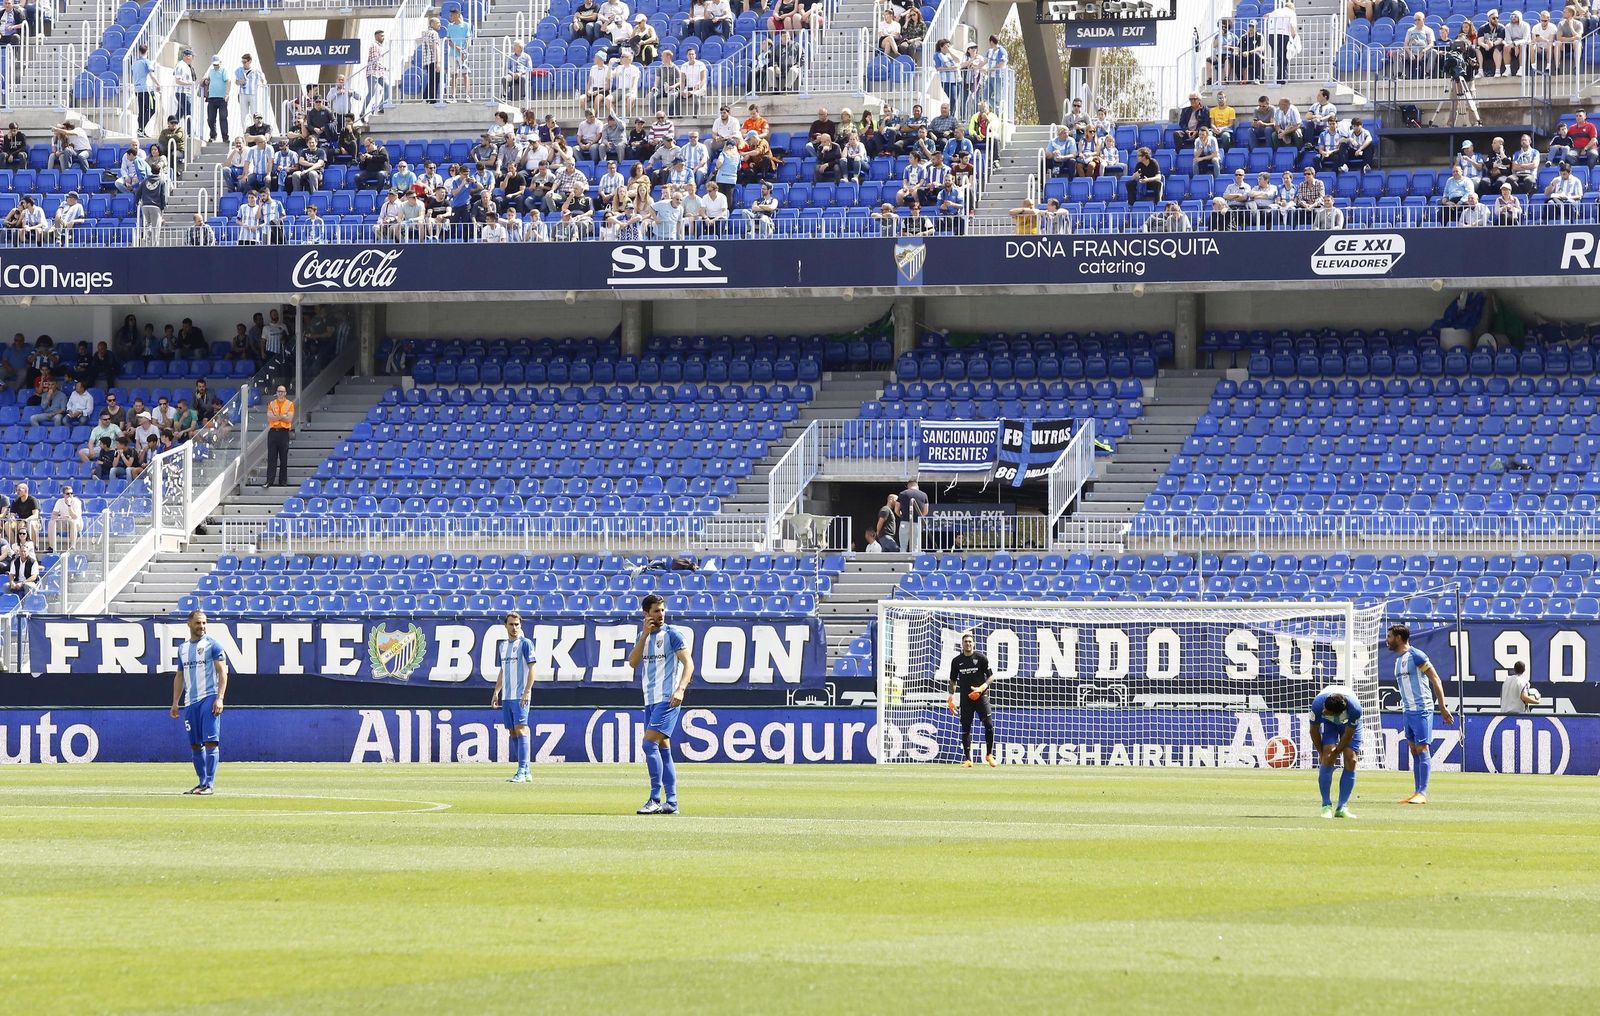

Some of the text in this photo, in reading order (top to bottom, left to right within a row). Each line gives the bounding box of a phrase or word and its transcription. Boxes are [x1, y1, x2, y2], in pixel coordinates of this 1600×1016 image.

[1076, 26, 1146, 38] SALIDA EXIT
[286, 45, 351, 56] SALIDA EXIT
[1005, 237, 1220, 259] DOÑA FRANCISQUITA
[1334, 239, 1392, 252] GE XXI
[1560, 231, 1600, 269] R
[292, 248, 404, 289] Coca-Cola
[611, 245, 721, 273] SUR
[1079, 260, 1146, 276] catering
[1315, 258, 1389, 269] ELEVADORES
[58, 271, 113, 294] viajes
[922, 429, 996, 444] SANCIONADOS
[1003, 427, 1071, 446] FB ULTRAS
[928, 447, 988, 461] PRESENTES
[994, 466, 1017, 480] 86
[932, 510, 1005, 521] SALIDA EXIT
[45, 622, 364, 676] FRENTE
[934, 627, 1183, 680] FONDO
[0, 711, 99, 763] uto
[679, 708, 940, 763] Seguros
